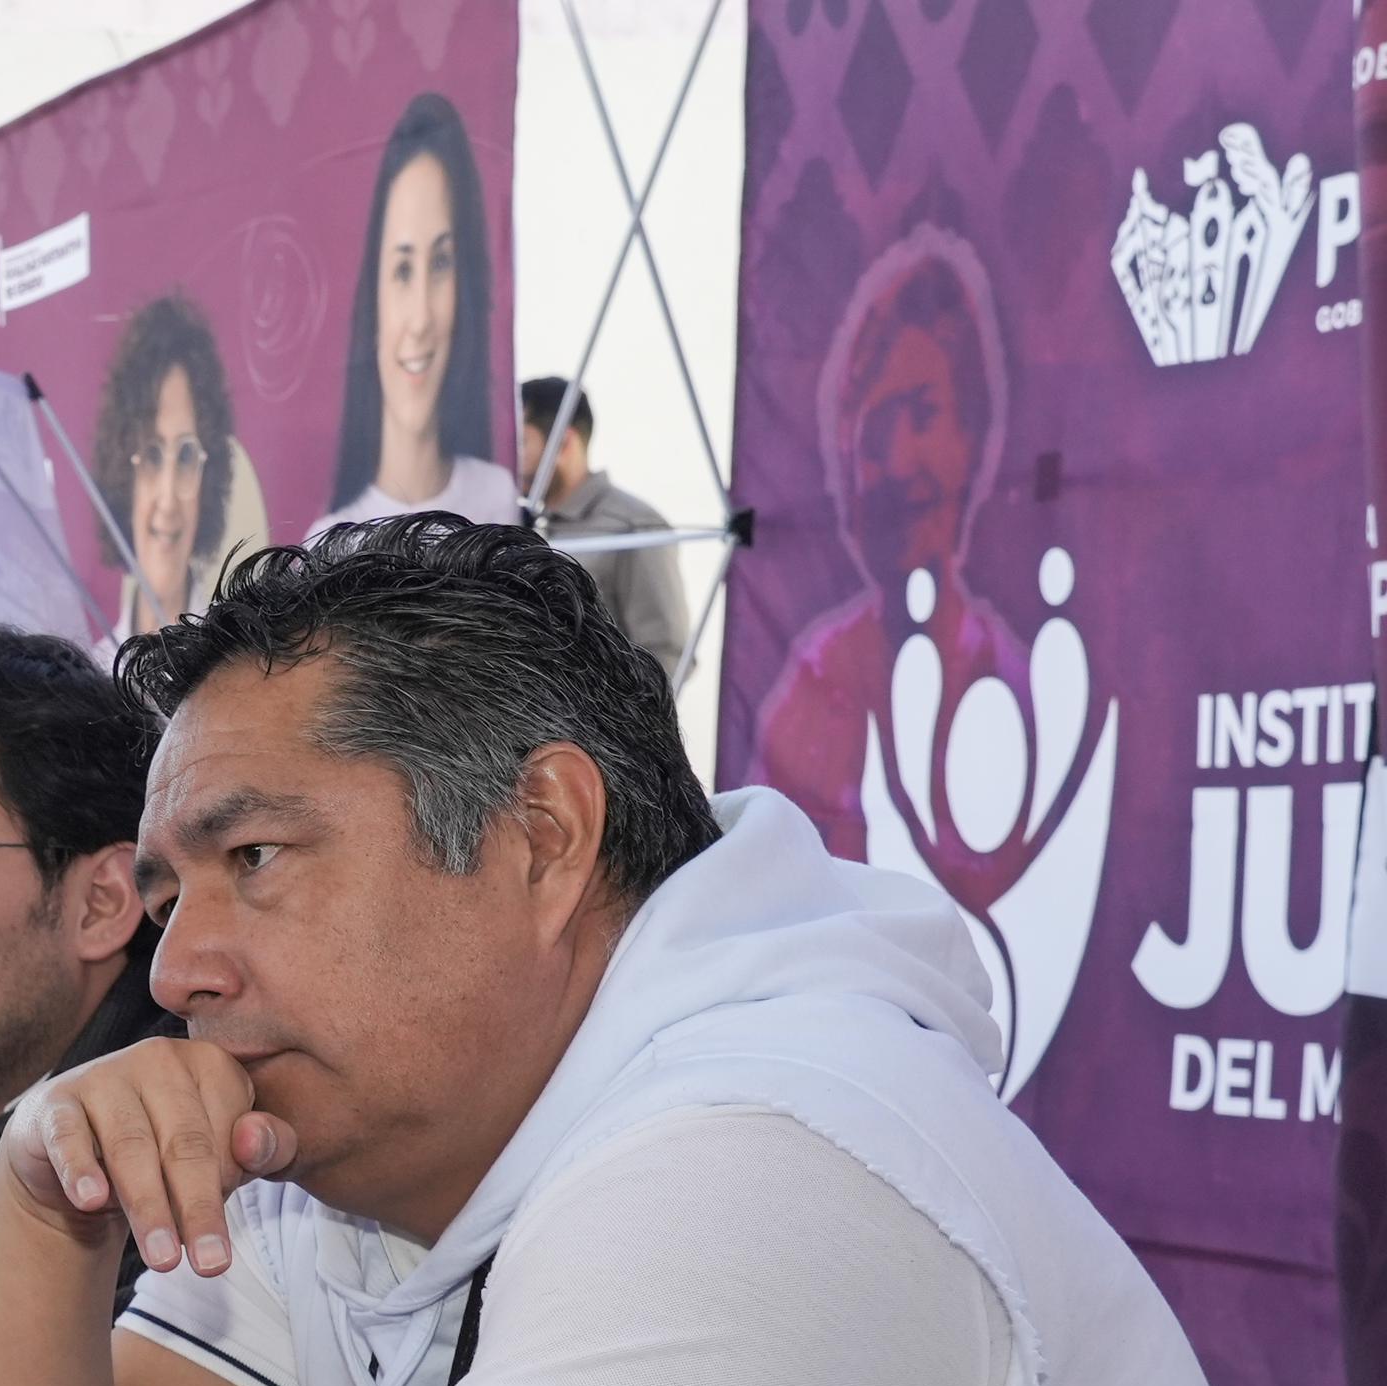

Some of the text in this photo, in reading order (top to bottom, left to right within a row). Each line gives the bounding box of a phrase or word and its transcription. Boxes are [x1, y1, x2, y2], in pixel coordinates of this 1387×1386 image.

[1195, 682, 1375, 769] INSTIT
[1131, 782, 1364, 1017] JU
[1169, 1034, 1287, 1121] DEL
